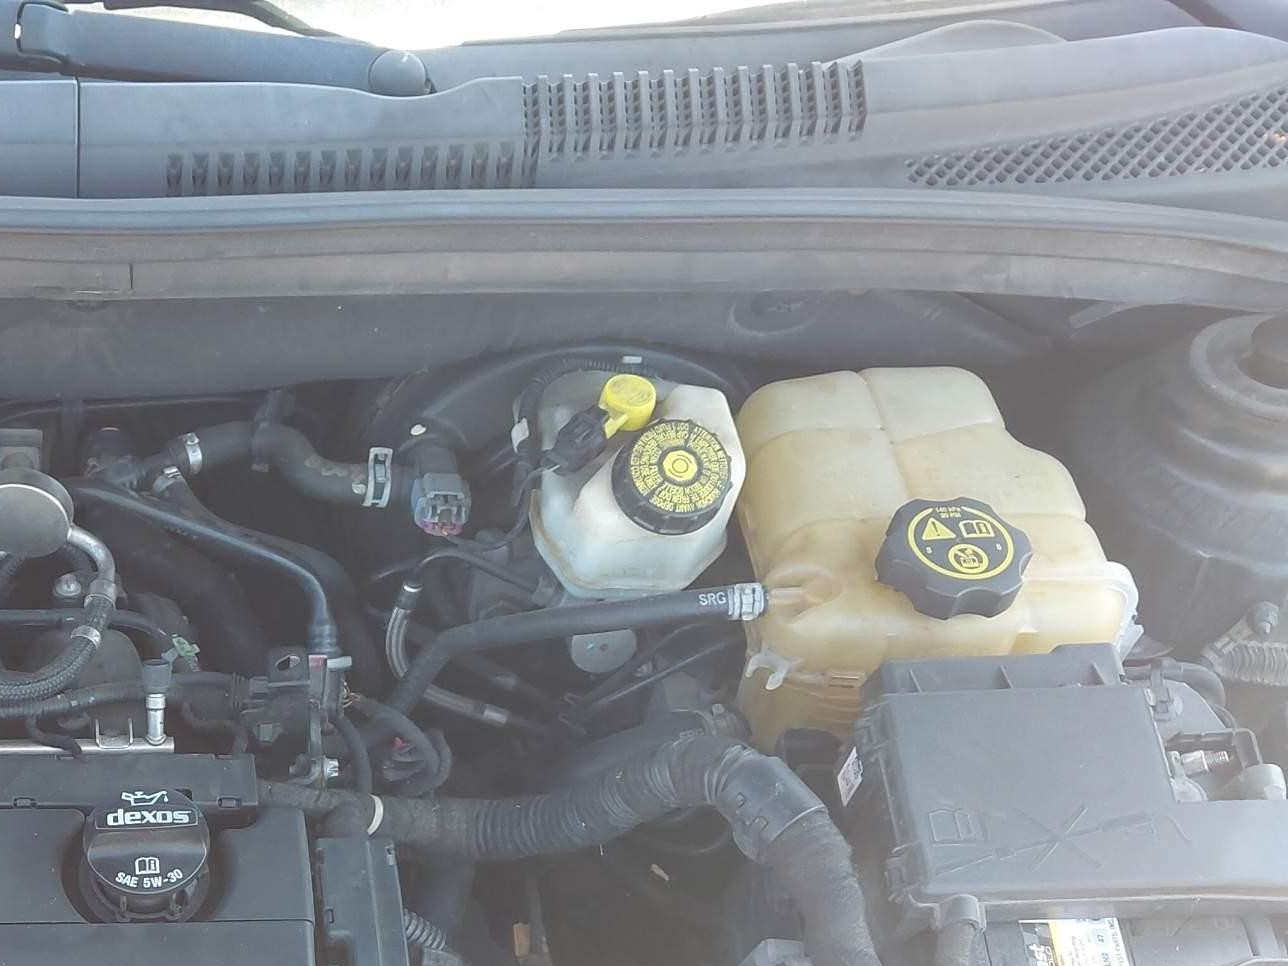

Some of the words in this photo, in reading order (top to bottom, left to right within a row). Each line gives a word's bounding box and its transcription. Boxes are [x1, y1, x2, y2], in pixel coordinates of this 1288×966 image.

[698, 592, 727, 606] SRG
[107, 809, 192, 826] dexos
[115, 872, 139, 888] SAE
[143, 868, 184, 888] 5W-30
